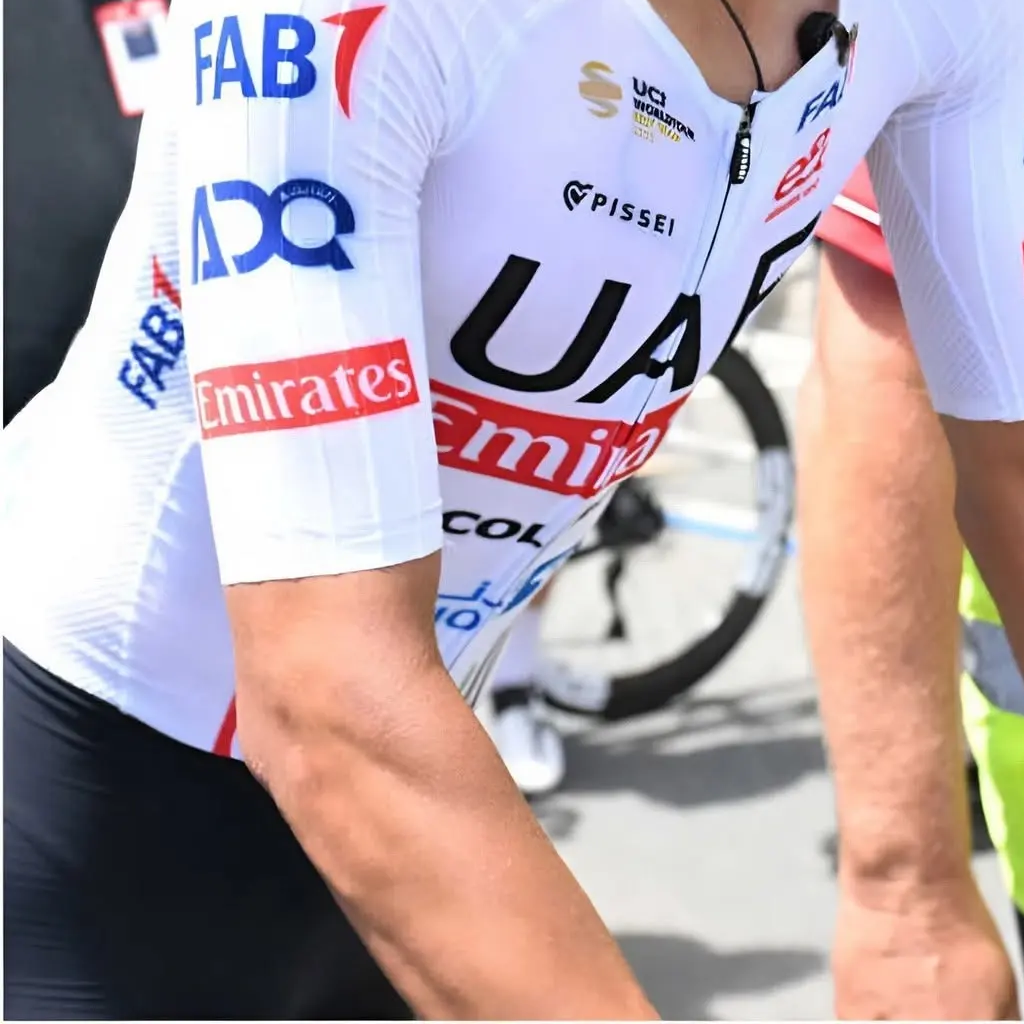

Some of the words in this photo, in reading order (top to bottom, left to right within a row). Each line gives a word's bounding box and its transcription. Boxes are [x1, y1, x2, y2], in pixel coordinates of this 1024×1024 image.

[194, 13, 317, 107] FAB
[795, 72, 846, 135] FA
[191, 178, 356, 286] ADQ
[590, 192, 676, 237] PISSEI
[117, 304, 185, 410] FAB
[196, 356, 413, 430] Emirates
[441, 510, 546, 549] COL
